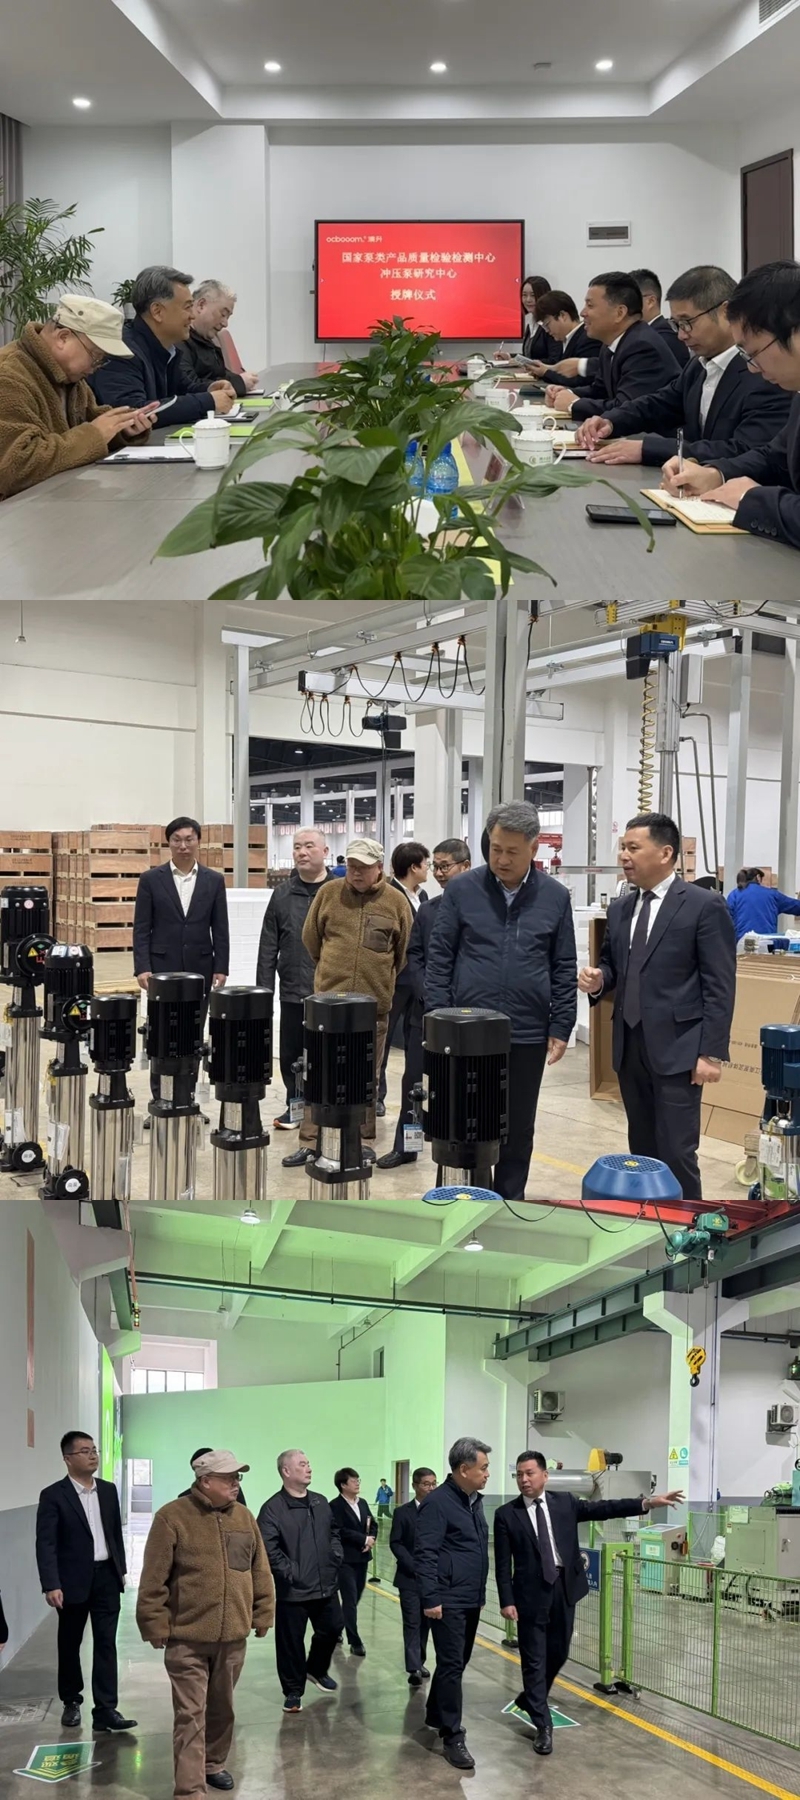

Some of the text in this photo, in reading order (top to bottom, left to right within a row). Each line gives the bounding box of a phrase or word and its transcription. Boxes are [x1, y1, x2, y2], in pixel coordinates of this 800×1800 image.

[342, 252, 496, 263] 国家泵类产品质量检验检测中心
[380, 268, 457, 279] 冲压泵研究中心
[390, 289, 436, 301] 授牌仪式
